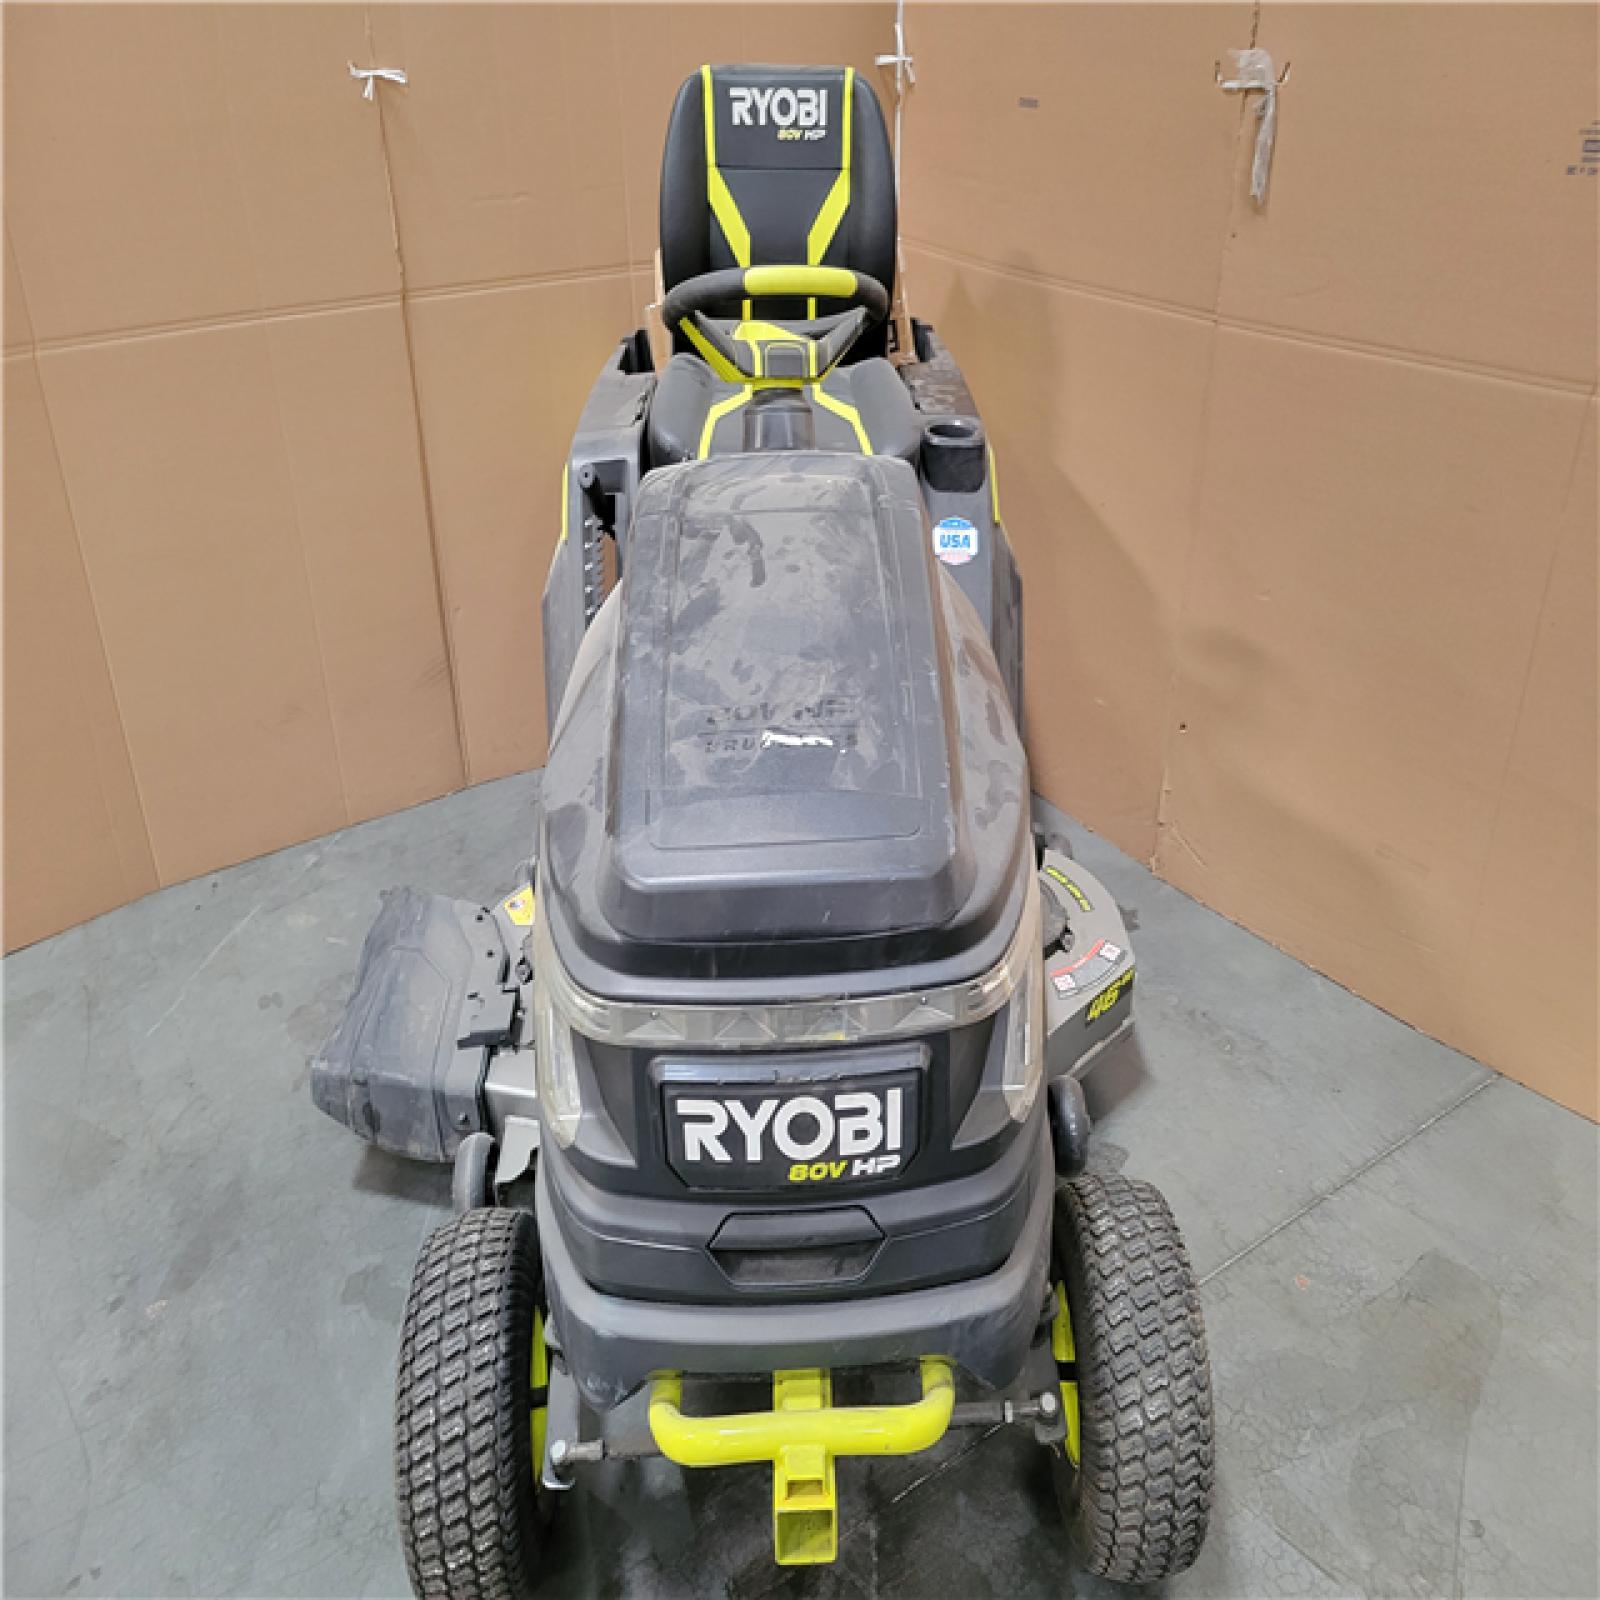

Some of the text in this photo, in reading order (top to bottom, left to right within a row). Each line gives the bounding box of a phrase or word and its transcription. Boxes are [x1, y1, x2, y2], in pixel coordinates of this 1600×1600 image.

[729, 87, 828, 126] RYOBI
[940, 534, 971, 548] USA
[675, 1088, 902, 1162] RYOBI
[851, 1154, 901, 1176] HP
